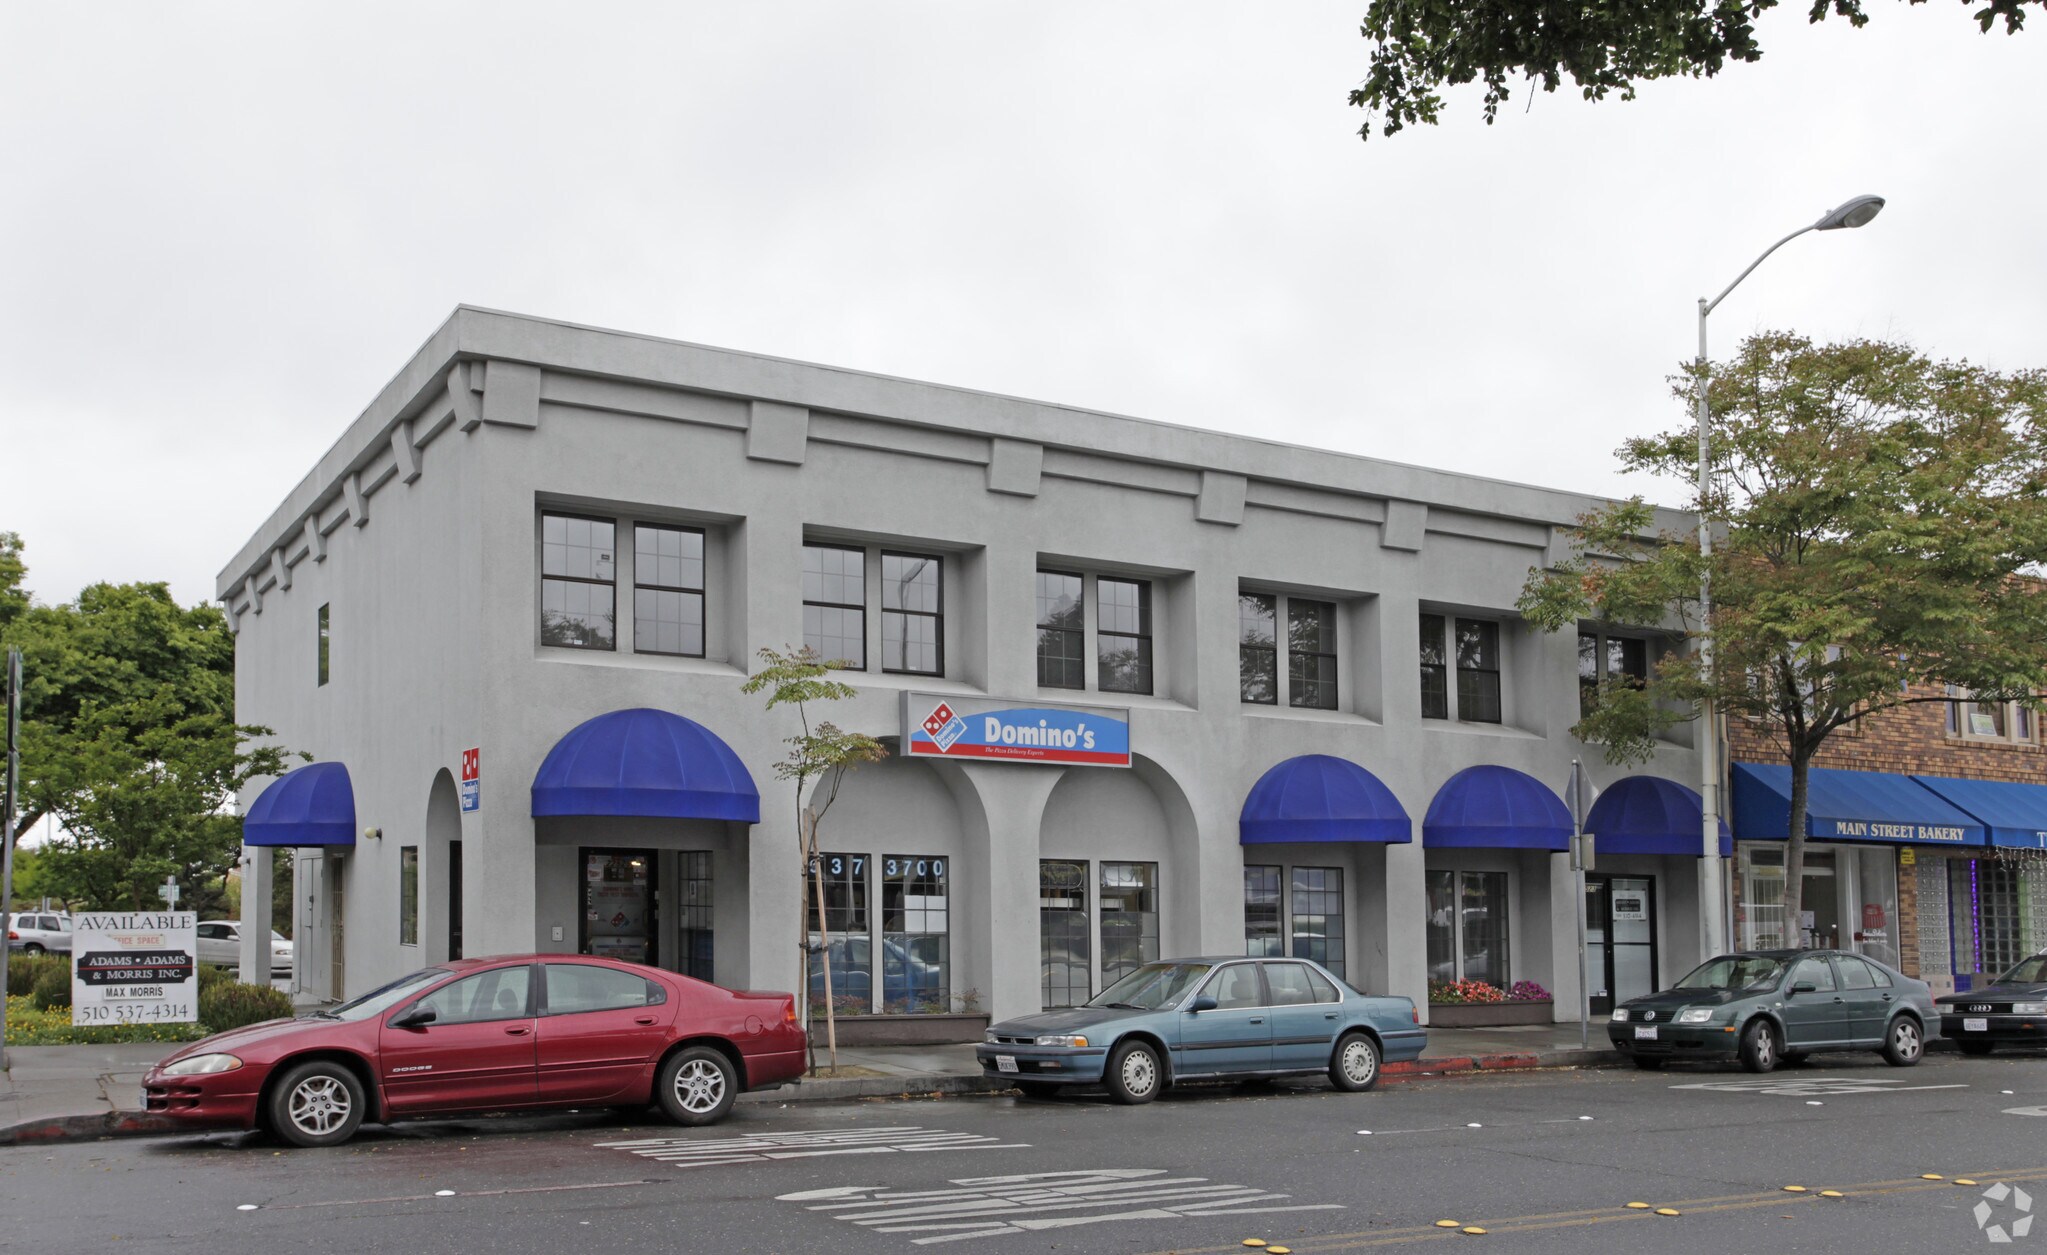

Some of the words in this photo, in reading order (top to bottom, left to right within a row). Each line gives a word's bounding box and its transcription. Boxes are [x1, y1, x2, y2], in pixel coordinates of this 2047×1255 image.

[936, 718, 959, 743] Domino's
[985, 717, 1096, 749] Domino's
[1007, 748, 1026, 756] Delivery
[1836, 821, 1867, 836] MAIN
[1871, 824, 1914, 838] STREET
[1918, 826, 1965, 841] BAKERY
[2037, 831, 2047, 848] T
[886, 860, 943, 876] 3700
[79, 916, 192, 930] AVAILABLE
[137, 936, 160, 945] SPACE
[89, 957, 132, 966] ADAMS
[144, 955, 186, 965] ADAMS
[93, 971, 101, 980] &
[107, 970, 153, 979] MORRIS
[158, 969, 182, 978] INC.
[106, 988, 125, 997] MAX
[130, 987, 163, 997] MORRIS
[82, 1006, 109, 1020] 510
[116, 1004, 188, 1019] 537-4314
